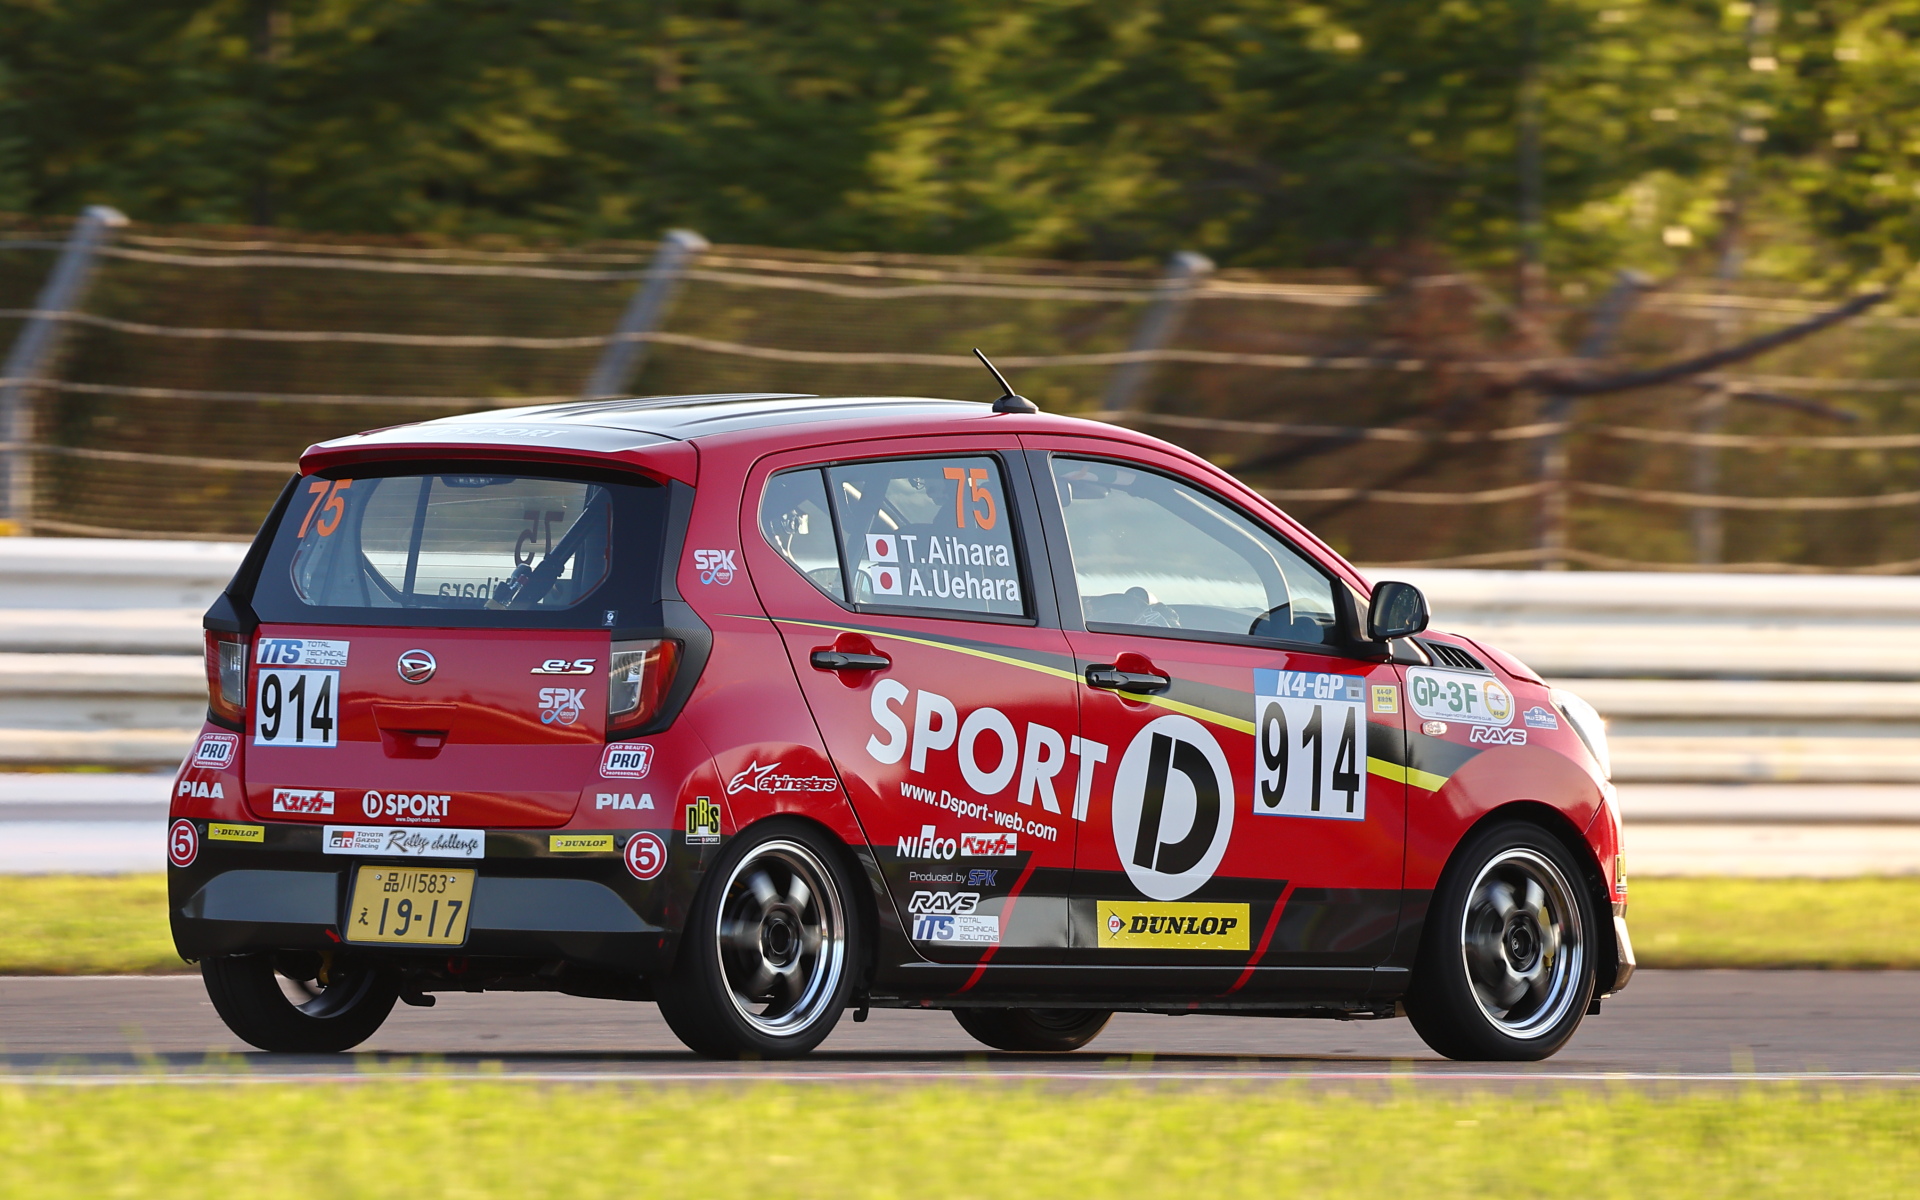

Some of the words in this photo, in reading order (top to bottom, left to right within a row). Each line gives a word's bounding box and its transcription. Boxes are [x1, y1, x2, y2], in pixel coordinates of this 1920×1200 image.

[464, 428, 569, 438] SPORT
[297, 478, 353, 539] 75
[943, 467, 997, 531] 75
[694, 549, 738, 570] SPK
[900, 535, 1010, 567] T.Aihara
[908, 568, 1020, 601] A.Uehara
[1276, 671, 1344, 699] K4-GP
[1413, 675, 1478, 714] GP-3F
[260, 673, 333, 743] 914
[538, 687, 587, 710] SPK
[1471, 728, 1526, 744] RAYS
[200, 743, 228, 759] PRO
[610, 753, 641, 768] PRO
[865, 678, 1109, 822] SPORT
[1261, 702, 1360, 813] 914
[178, 781, 224, 799] PIAA
[759, 775, 837, 794] alpinestars
[274, 792, 333, 813] ベストカー
[385, 793, 451, 816] SPORT
[595, 793, 655, 810] PIAA
[900, 781, 1058, 842] www.Dsport-web.com
[688, 798, 719, 834] DRS
[174, 828, 191, 858] 5
[220, 828, 259, 837] DUNLOP
[331, 837, 353, 848] GR
[385, 830, 430, 854] Rally
[896, 824, 957, 860] NIFCO
[354, 842, 379, 850] Racing
[962, 834, 1015, 855] ベストカー
[635, 840, 657, 871] 5
[909, 871, 953, 882] Produced
[955, 872, 967, 884] by
[967, 868, 998, 887] SPK
[909, 893, 979, 913] RAYS
[358, 906, 369, 926] え
[378, 897, 463, 938] 19-17
[959, 916, 981, 924] TOTAL
[1127, 915, 1238, 935] DUNLOP
[959, 925, 998, 933] TECHNICAL
[959, 933, 999, 941] SOLUTIONS
